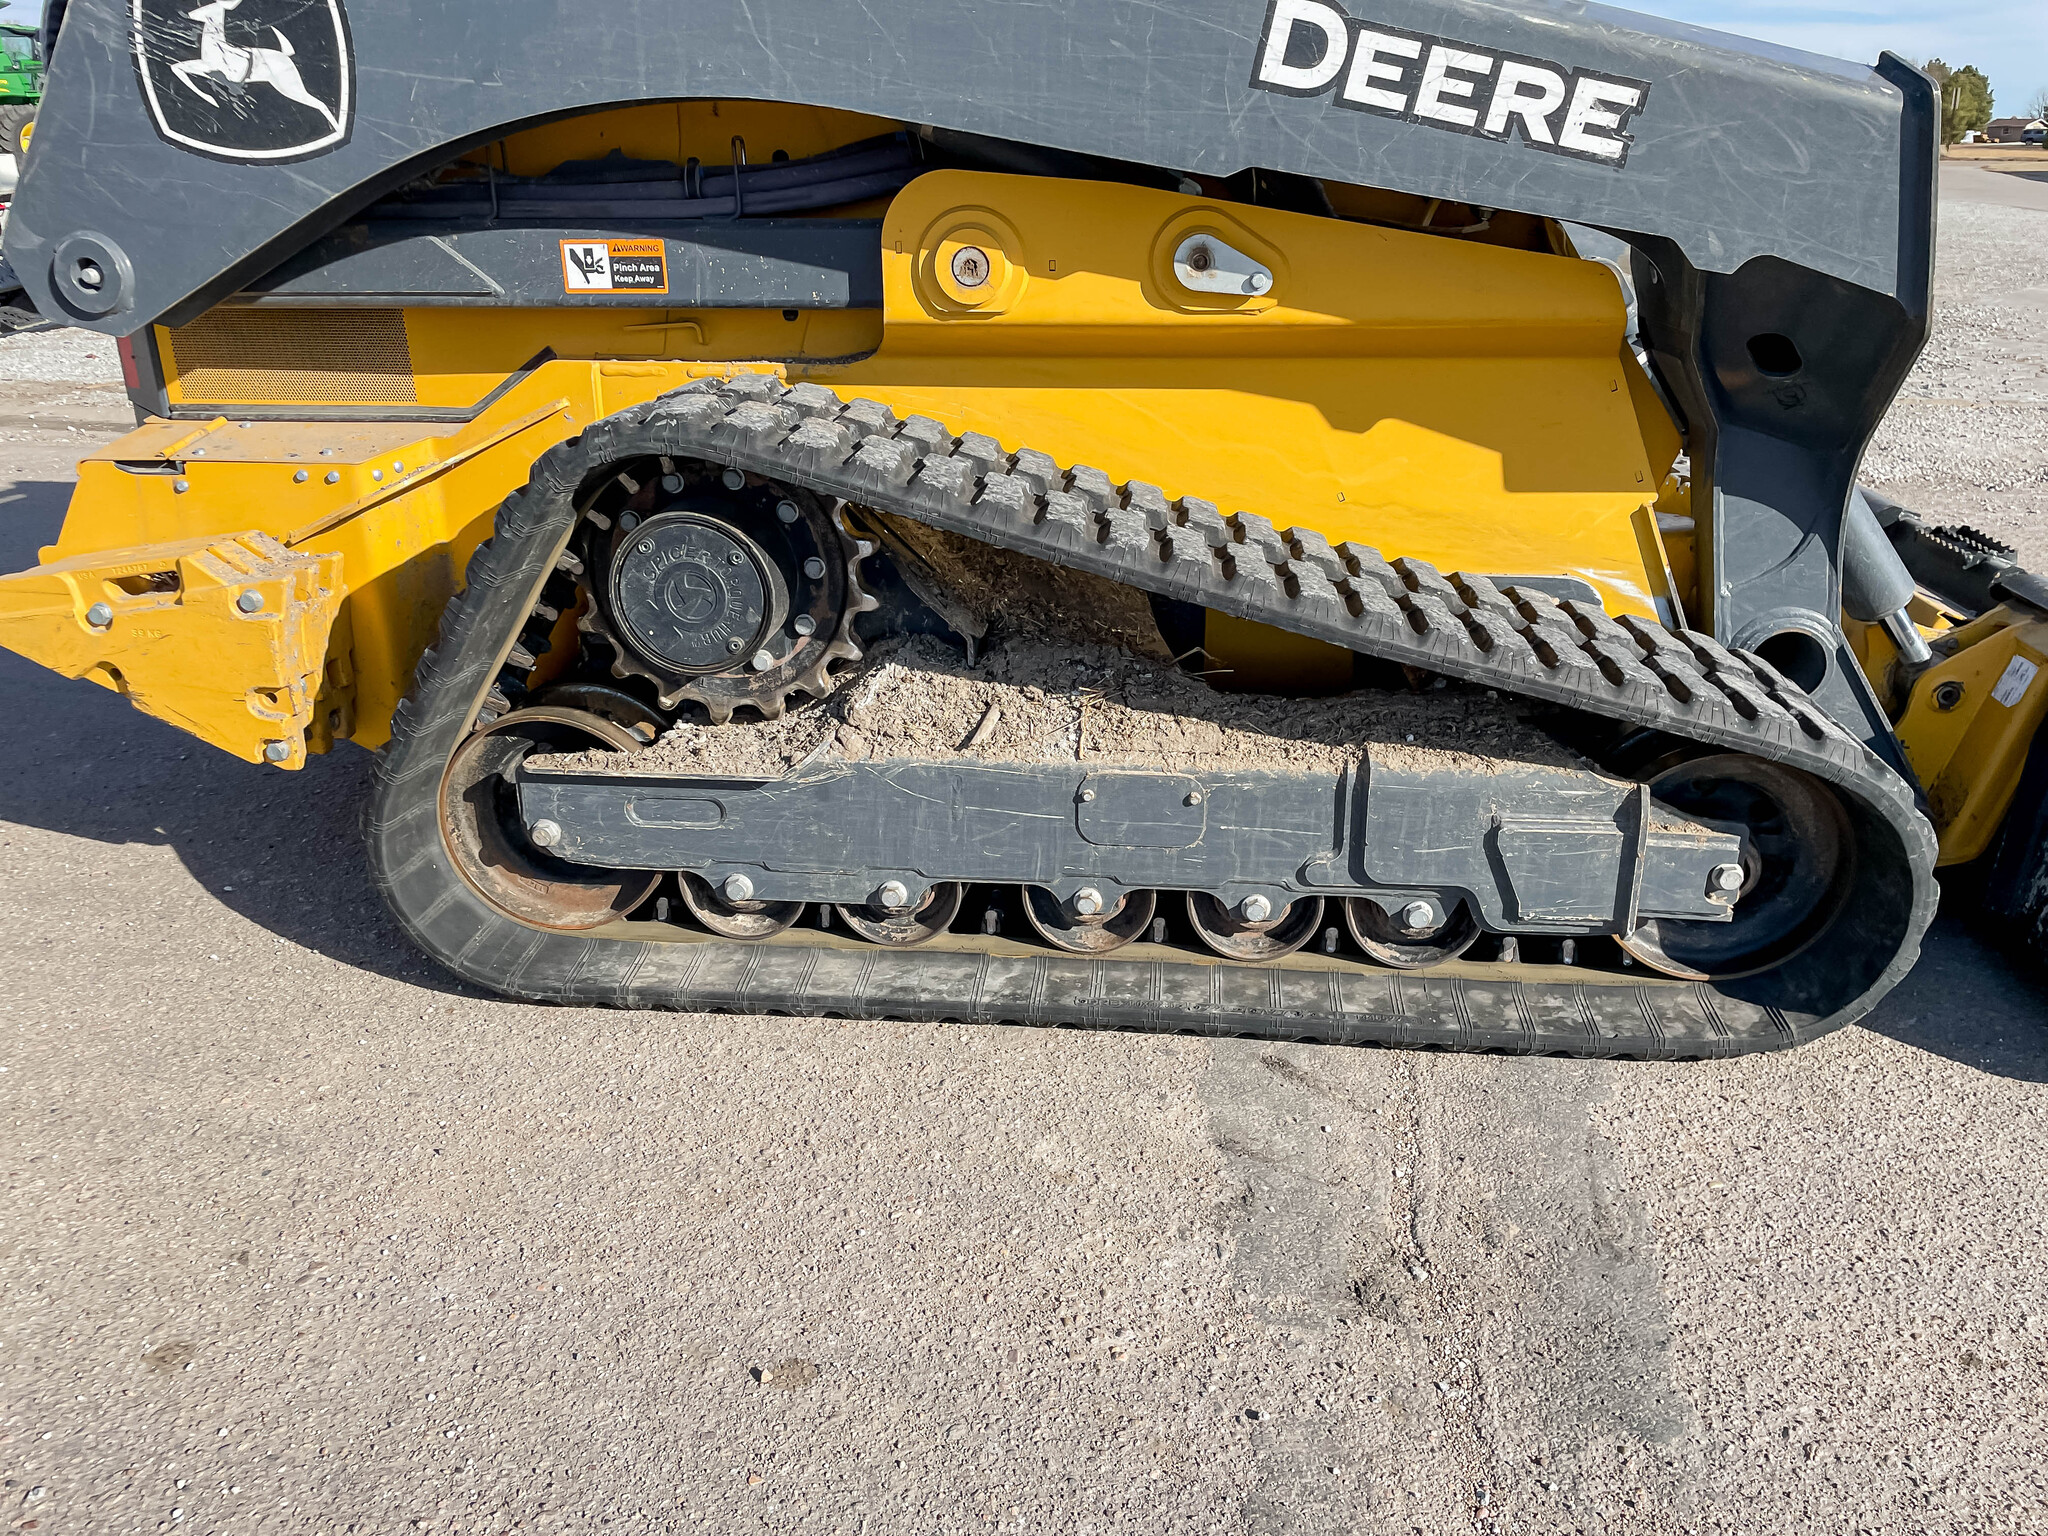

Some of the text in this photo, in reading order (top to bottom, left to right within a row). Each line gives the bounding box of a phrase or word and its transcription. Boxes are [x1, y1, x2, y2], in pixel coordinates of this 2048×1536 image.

[1259, 0, 1641, 158] DEERE
[620, 244, 660, 252] WARNING
[613, 262, 660, 272] Pinch Area
[614, 275, 655, 284] Keep Away
